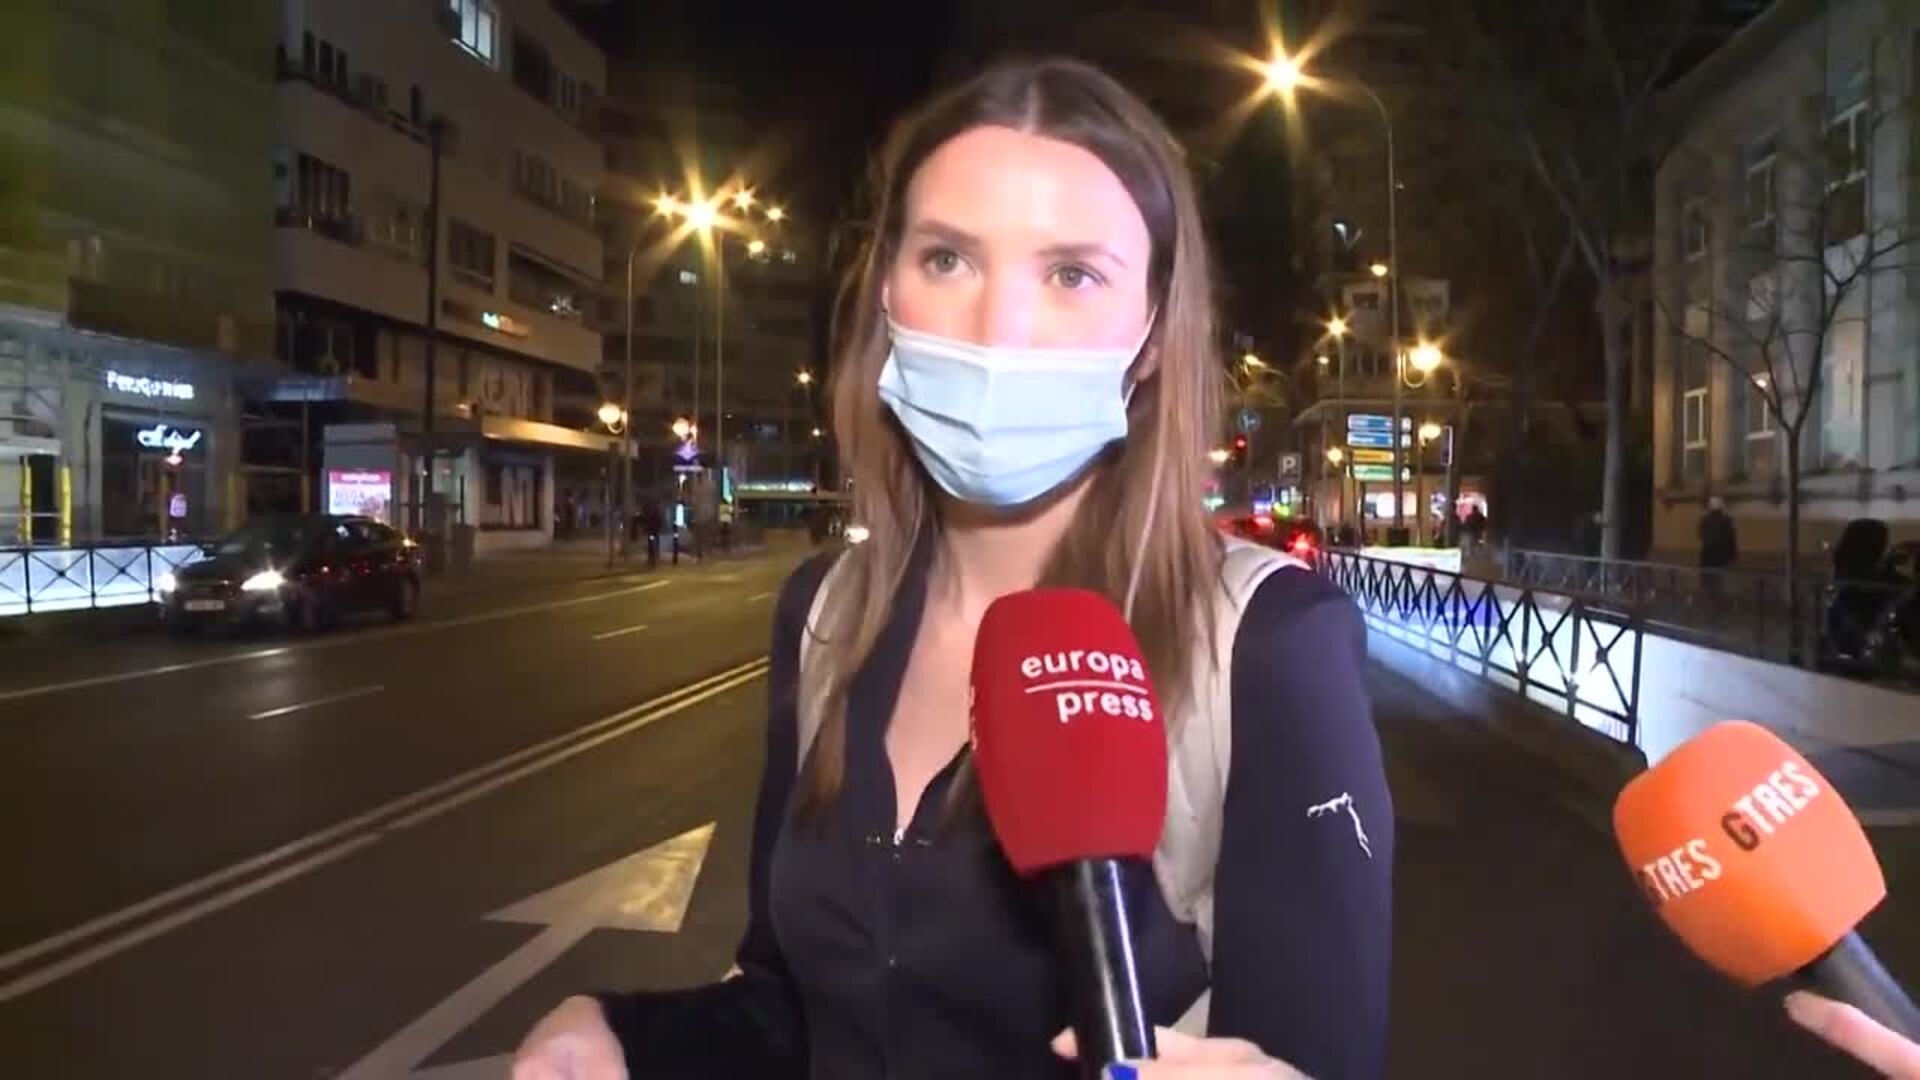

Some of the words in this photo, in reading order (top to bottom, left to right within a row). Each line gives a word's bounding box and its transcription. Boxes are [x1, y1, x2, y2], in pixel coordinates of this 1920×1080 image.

[1282, 455, 1297, 474] P
[1021, 650, 1145, 681] europa
[1056, 690, 1154, 723] press
[1636, 839, 1722, 901] TRES
[1721, 761, 1821, 852] GTRES
